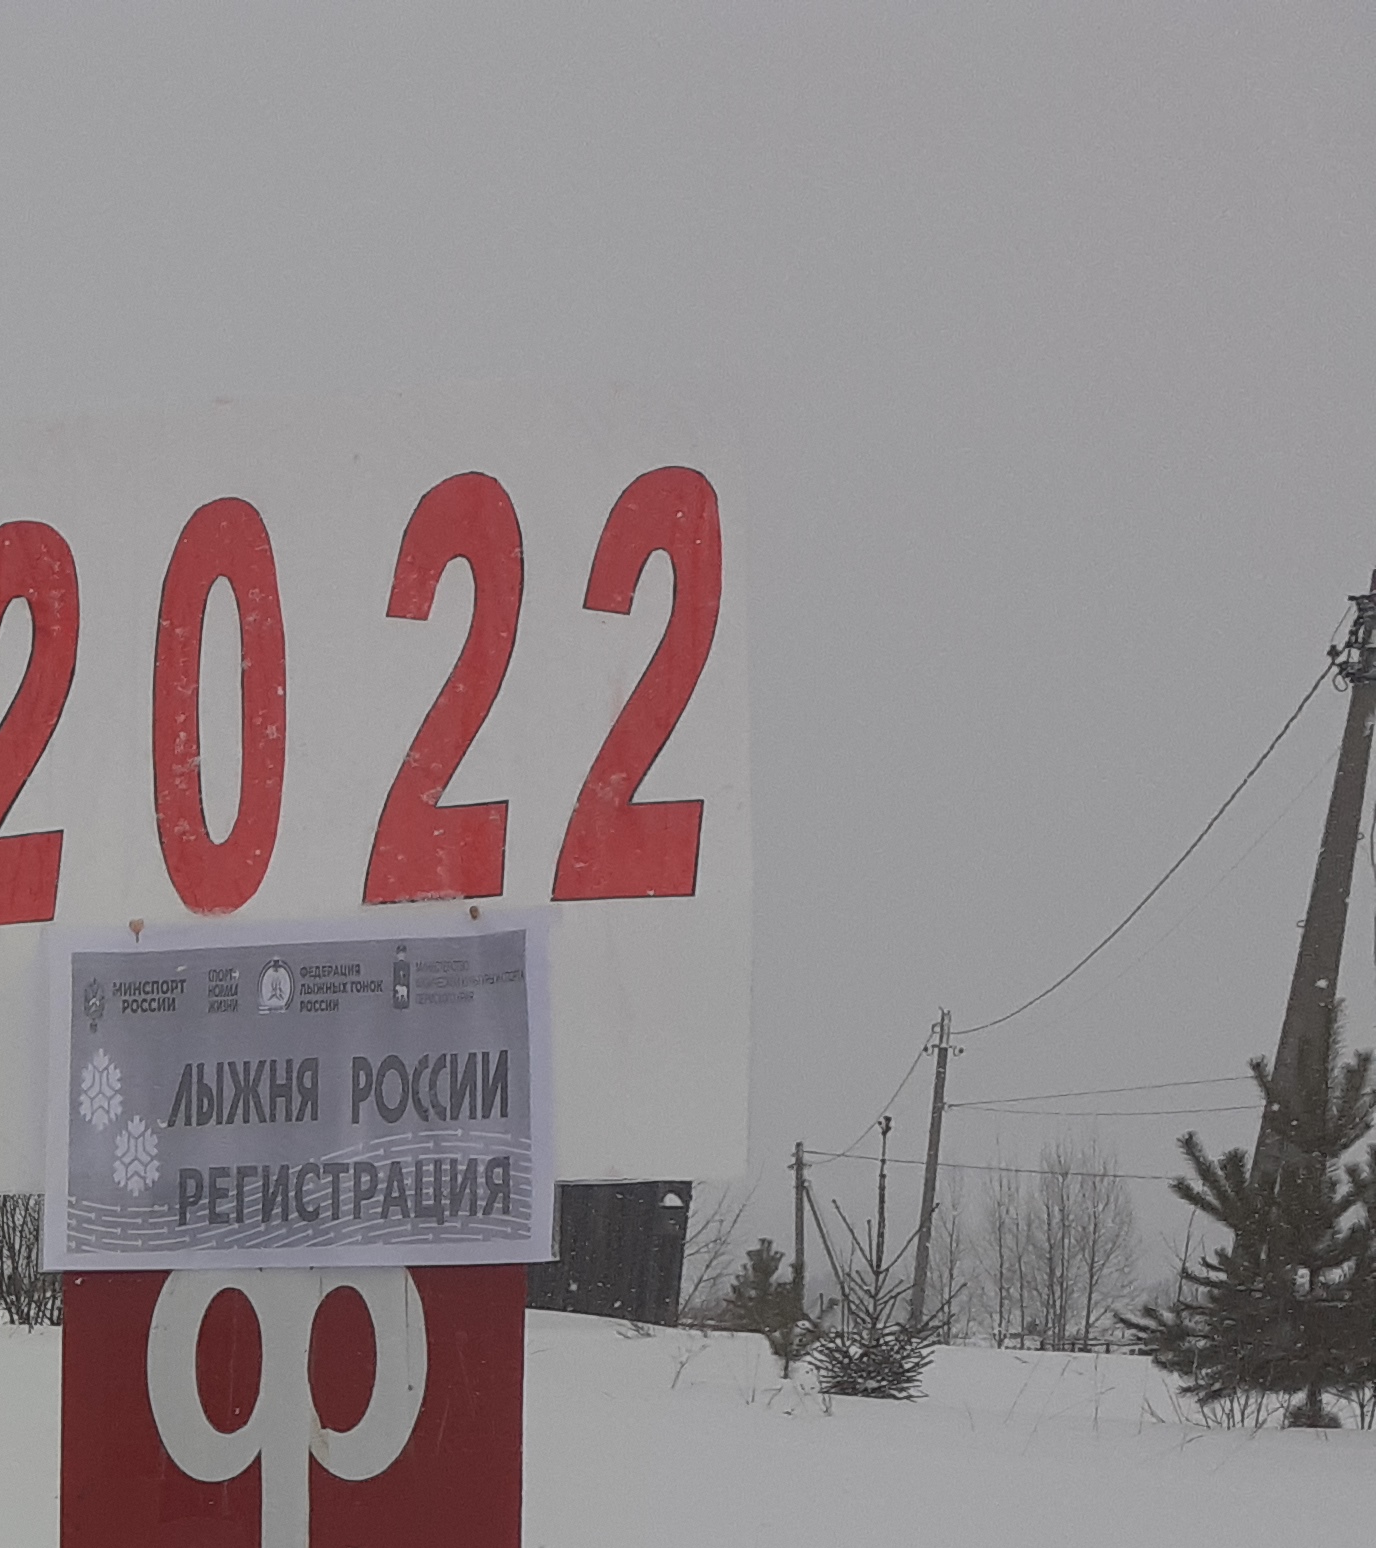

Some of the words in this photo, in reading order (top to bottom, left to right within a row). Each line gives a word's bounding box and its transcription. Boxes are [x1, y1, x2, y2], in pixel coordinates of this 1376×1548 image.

[299, 963, 361, 979] ФЕДЕРАЦИЯ
[112, 978, 187, 997] МИНСПОРТ
[299, 982, 348, 996] ЛЫЖНЫХ
[350, 980, 384, 993] ГОНОК
[121, 997, 176, 1014] РОССИИ
[299, 1000, 340, 1013] РОССИИ
[167, 1057, 319, 1129] ЛЫЖНЯ
[351, 1049, 509, 1125] РОССИИ
[177, 1156, 512, 1226] РЕГИСТРАЦИЯ
